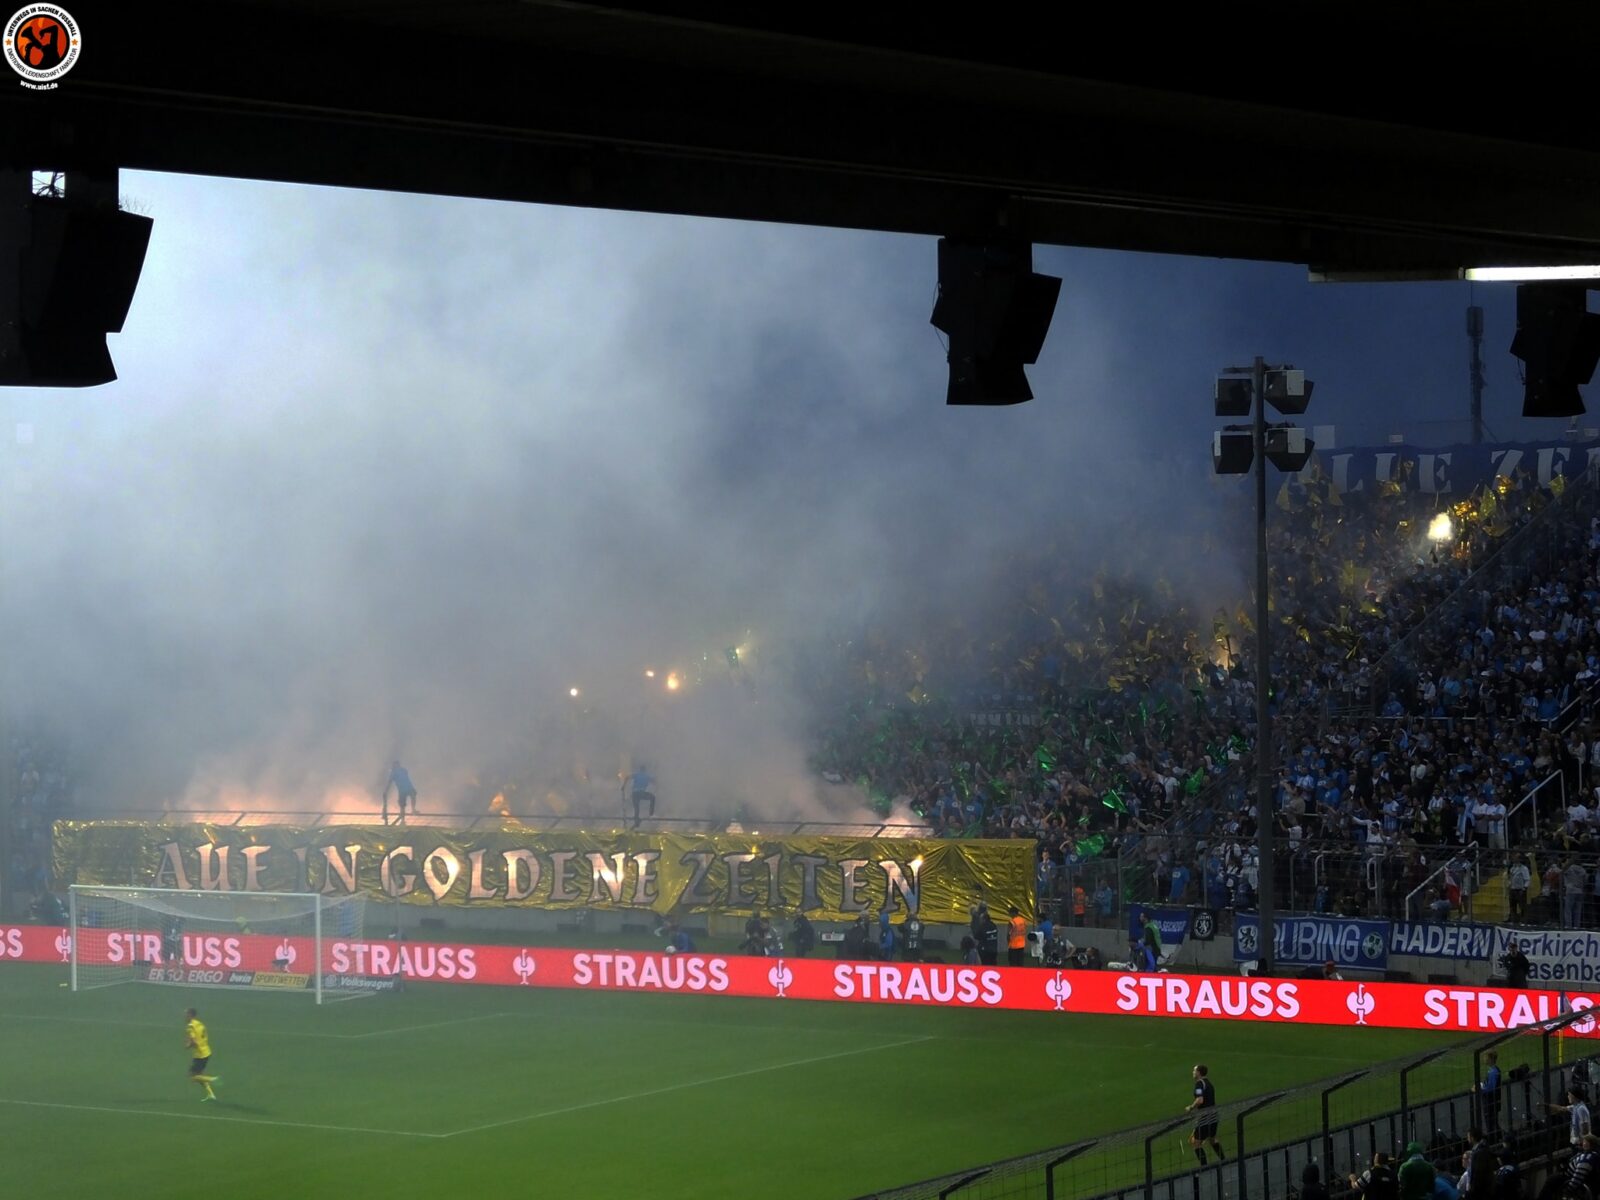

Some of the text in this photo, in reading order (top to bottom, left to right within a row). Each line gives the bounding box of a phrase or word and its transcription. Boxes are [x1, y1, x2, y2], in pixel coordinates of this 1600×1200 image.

[151, 841, 272, 891] AUF
[380, 846, 661, 905] GOLDENE
[674, 850, 923, 914] ZEITEN
[106, 931, 241, 968] STRUSS
[1391, 923, 1491, 957] HADERN
[187, 970, 224, 983] ERGO
[331, 943, 476, 980] STRAUSS
[573, 953, 729, 992] STRAUSS
[1526, 958, 1600, 982] asenba
[340, 976, 394, 990] Volkswagen
[834, 965, 1003, 1005] STRAUSS
[1116, 976, 1300, 1019] STRAUSS
[1423, 988, 1600, 1037] STRAUS
